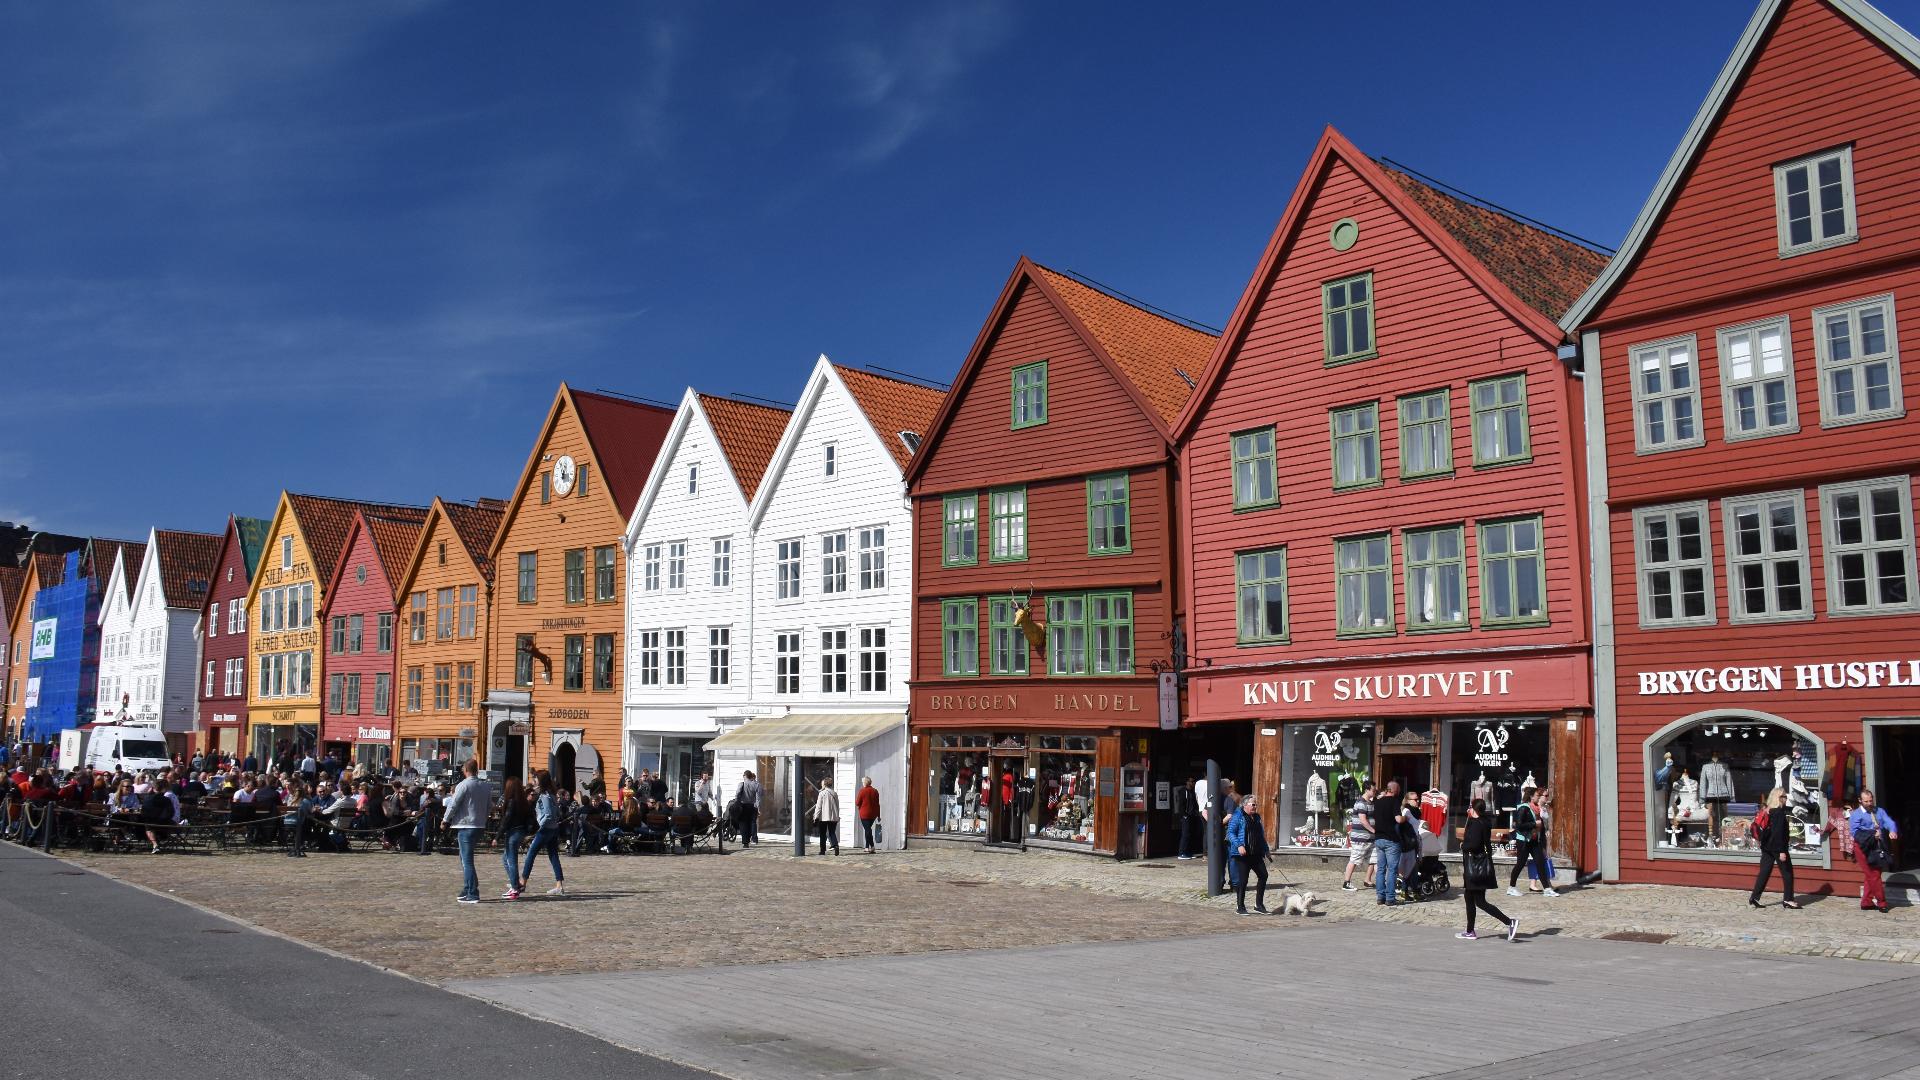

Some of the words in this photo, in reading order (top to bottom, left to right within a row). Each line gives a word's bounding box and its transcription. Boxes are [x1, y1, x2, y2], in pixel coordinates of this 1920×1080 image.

[1243, 679, 1315, 706] KNUT
[1333, 669, 1514, 701] SKURTVEIT
[1638, 666, 1783, 695] BRYGGEN
[931, 695, 1019, 711] BRYGGEN
[1054, 694, 1141, 712] HANDEL
[1474, 753, 1509, 761] AUDHILD
